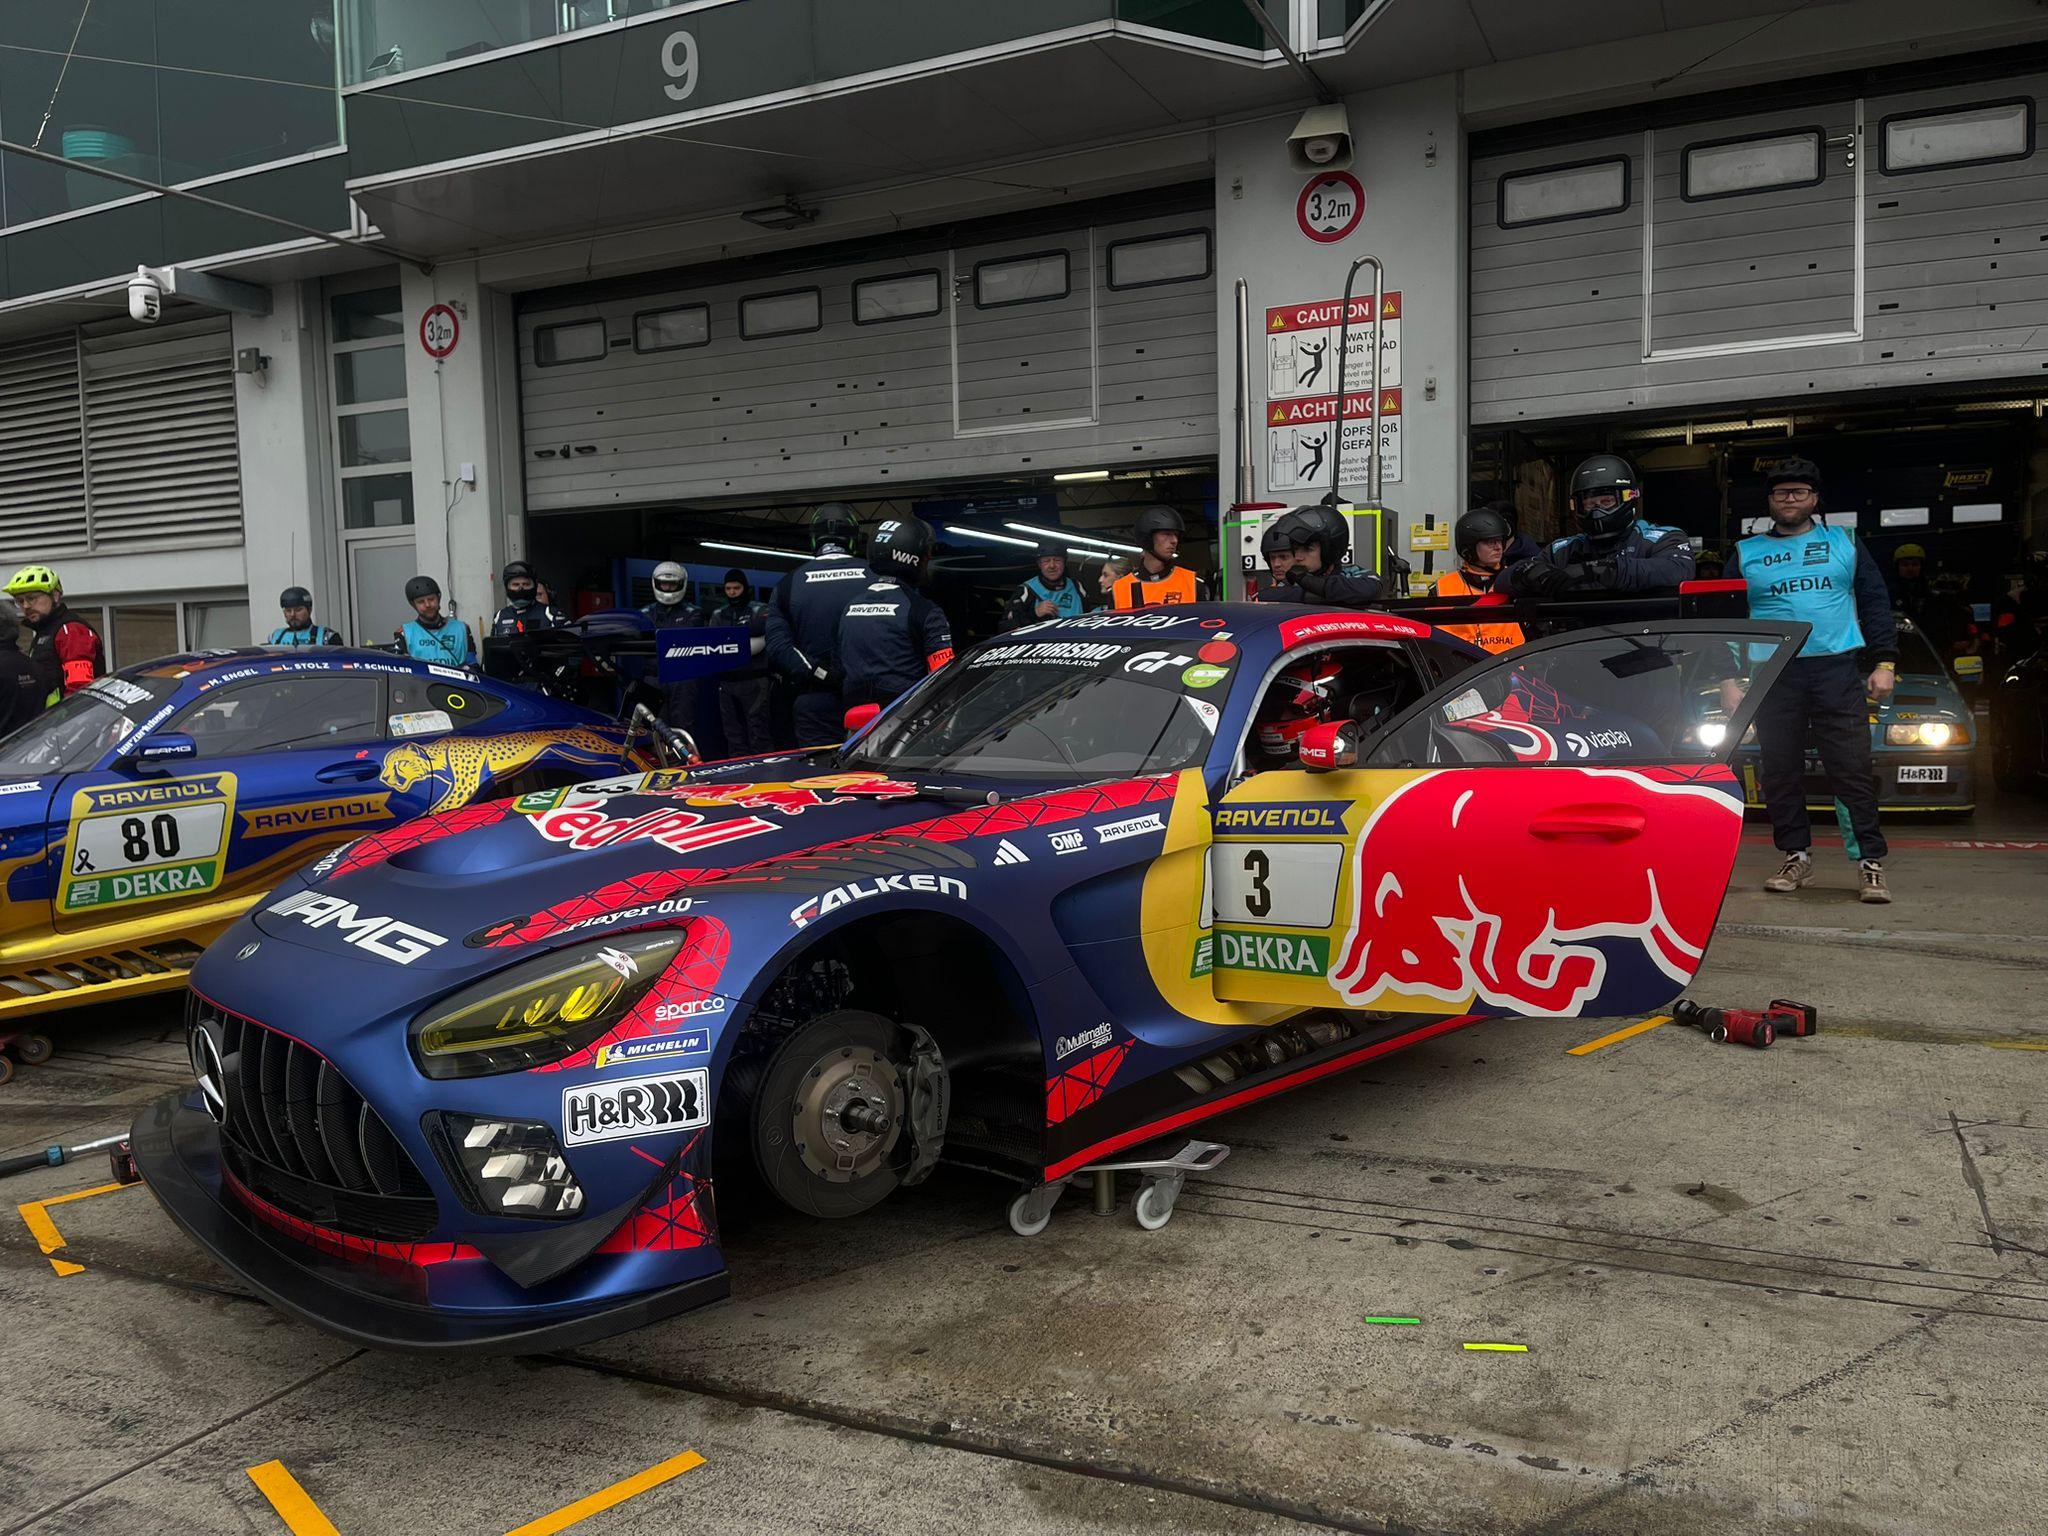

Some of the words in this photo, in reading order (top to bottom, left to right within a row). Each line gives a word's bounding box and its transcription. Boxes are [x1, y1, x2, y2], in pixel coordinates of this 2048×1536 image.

[661, 30, 699, 100] 9
[427, 321, 452, 342] 32m
[1367, 341, 1397, 352] HAD
[1344, 362, 1365, 371] anger
[1342, 422, 1398, 437] OPFSOß
[1342, 437, 1390, 451] GEFAR
[1340, 456, 1360, 466] efahr
[1243, 556, 1253, 569] 9
[1763, 551, 1792, 567] 044
[1770, 576, 1833, 597] MEDIA
[1056, 614, 1198, 630] viaplay
[1316, 622, 1370, 632] VERSTAPPEN
[1393, 626, 1418, 635] AUER
[428, 657, 458, 667] EDIA
[973, 644, 1029, 664] GRAN
[282, 663, 293, 671] L.
[294, 662, 330, 670] STOLZ
[365, 664, 412, 674] SCHILLER
[1004, 658, 1042, 666] DRIVING
[1041, 658, 1100, 669] SIMULATOR
[224, 668, 259, 683] ENGEL
[1586, 729, 1632, 750] viaplay
[159, 745, 192, 754] AMG
[1901, 768, 1927, 780] H&R
[0, 783, 35, 793] ENOL
[99, 783, 214, 807] RAVENOL
[256, 800, 381, 830] RAVENOL
[1215, 809, 1336, 827] RAVENOL
[1102, 818, 1159, 838] RAVENOL
[121, 813, 181, 863] 80
[1051, 832, 1084, 851] OMP
[112, 866, 206, 900] DEKRA
[1244, 849, 1272, 917] 3
[788, 874, 967, 929] FALKEN
[282, 893, 449, 965] AMG
[1220, 934, 1320, 973] DEKRA
[655, 997, 726, 1020] sparco
[1066, 1021, 1112, 1052] Multimatic
[627, 1037, 700, 1056] MICHELIN
[569, 1087, 649, 1134] H&R
